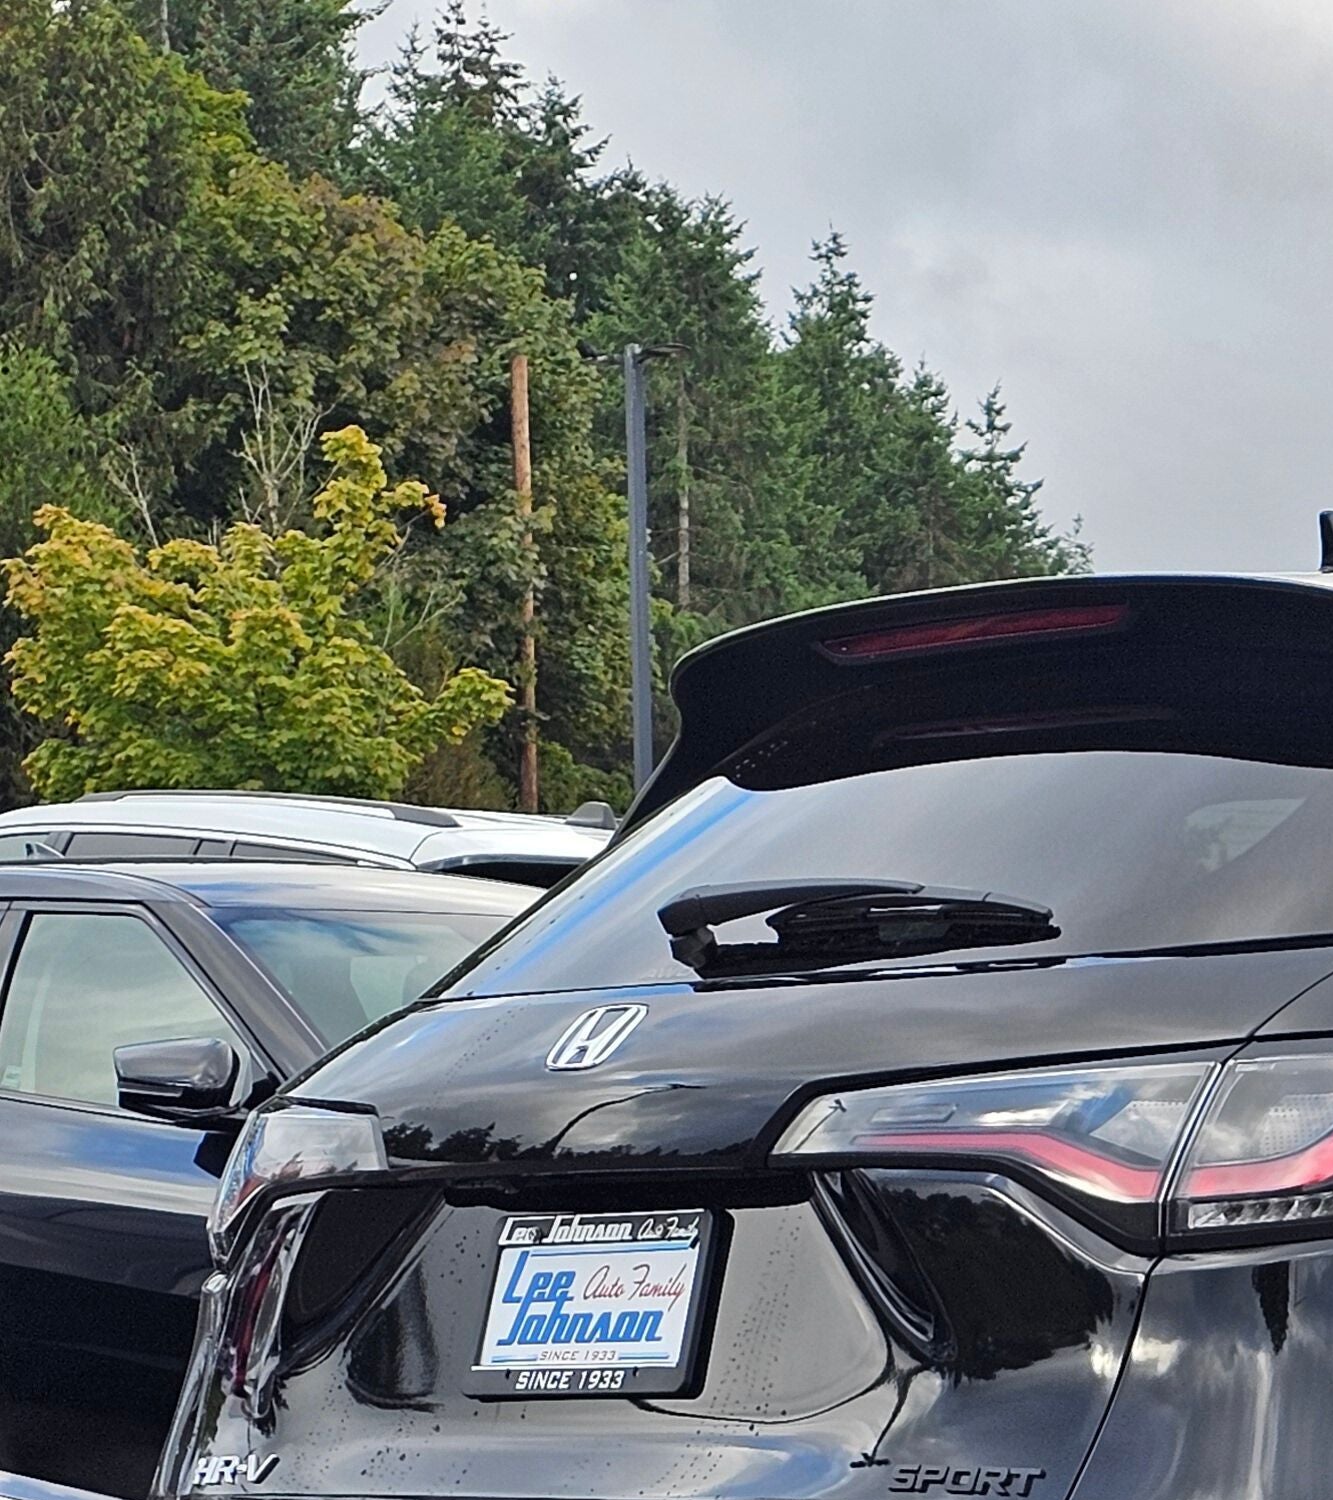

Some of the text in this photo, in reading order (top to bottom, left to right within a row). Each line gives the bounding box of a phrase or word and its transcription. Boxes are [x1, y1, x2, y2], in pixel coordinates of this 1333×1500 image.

[541, 1214, 633, 1243] Johnson
[502, 1250, 687, 1312] Lee Auto Family
[496, 1299, 664, 1346] Johnson
[539, 1350, 617, 1362] SINCE 1933
[515, 1370, 626, 1390] SINCE 1933
[193, 1454, 280, 1485] HR-V
[888, 1464, 1047, 1498] SPORT
